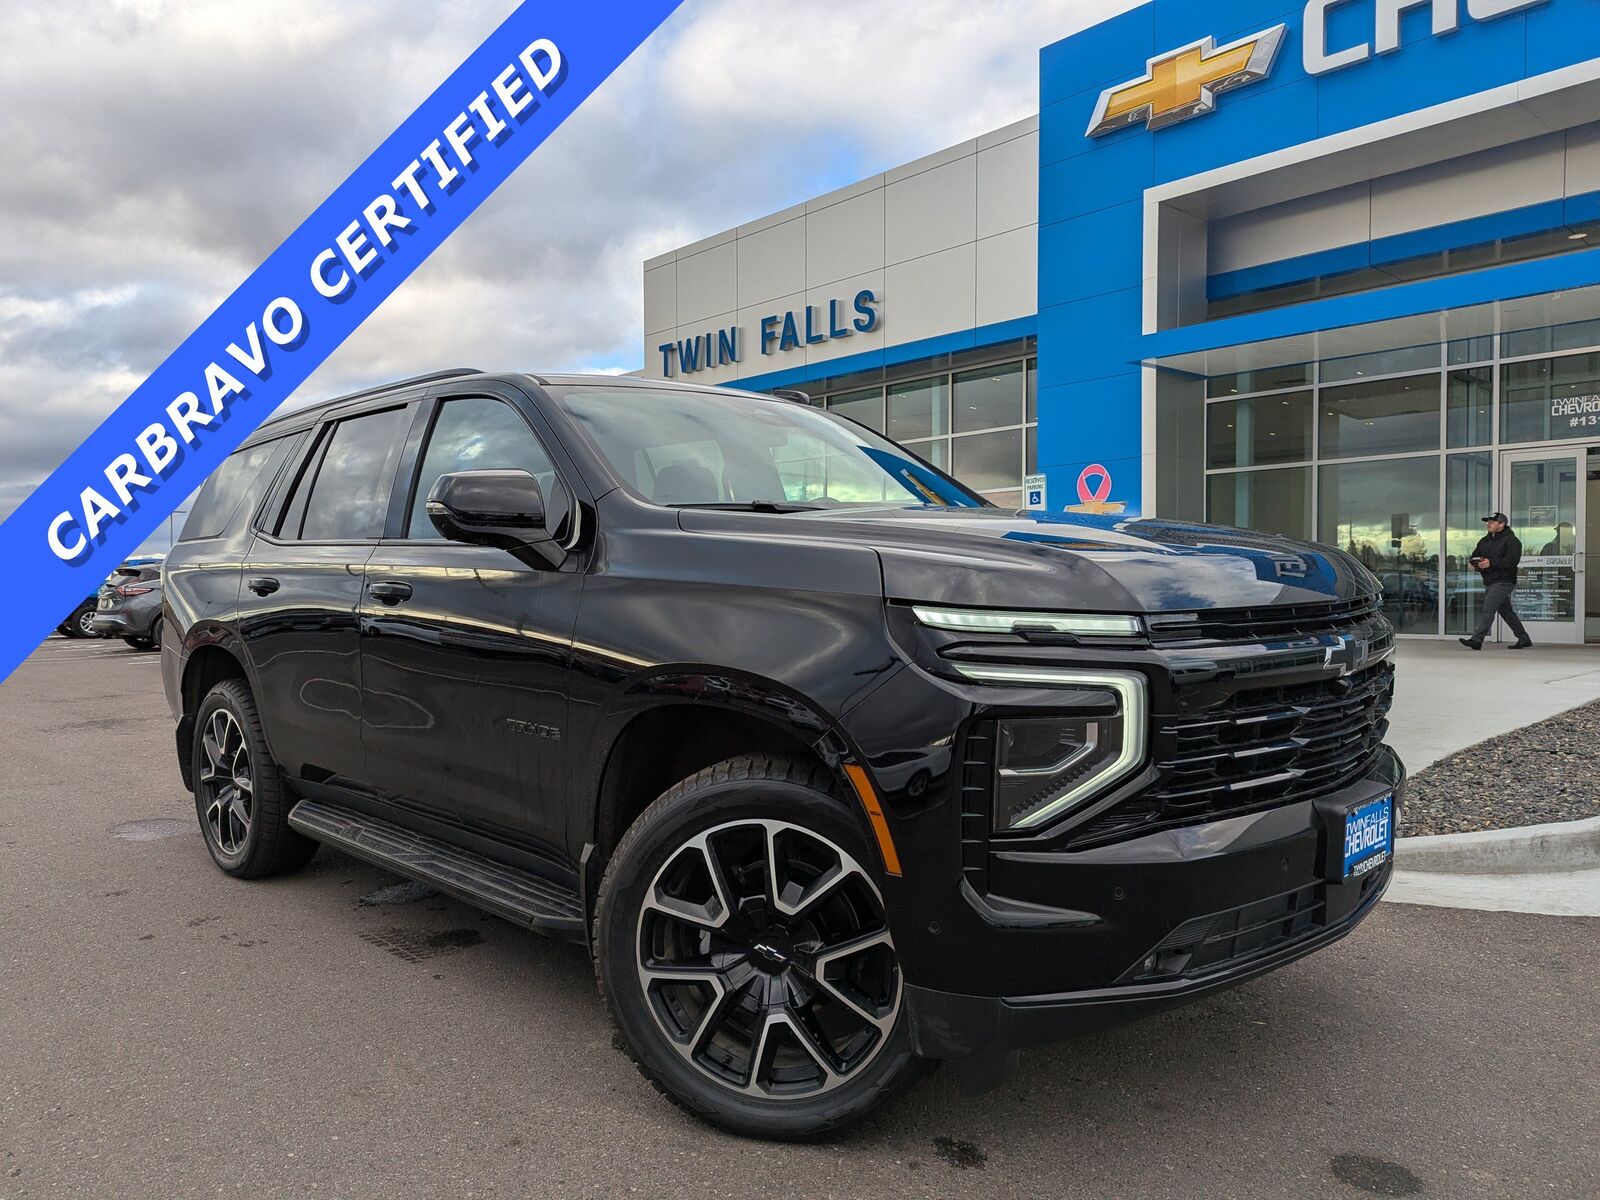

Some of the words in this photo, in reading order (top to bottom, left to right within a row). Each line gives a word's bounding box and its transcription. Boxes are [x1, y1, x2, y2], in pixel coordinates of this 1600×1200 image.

[658, 326, 741, 378] TWIN
[761, 289, 880, 355] FALLS
[1344, 818, 1389, 858] CHEVROLET
